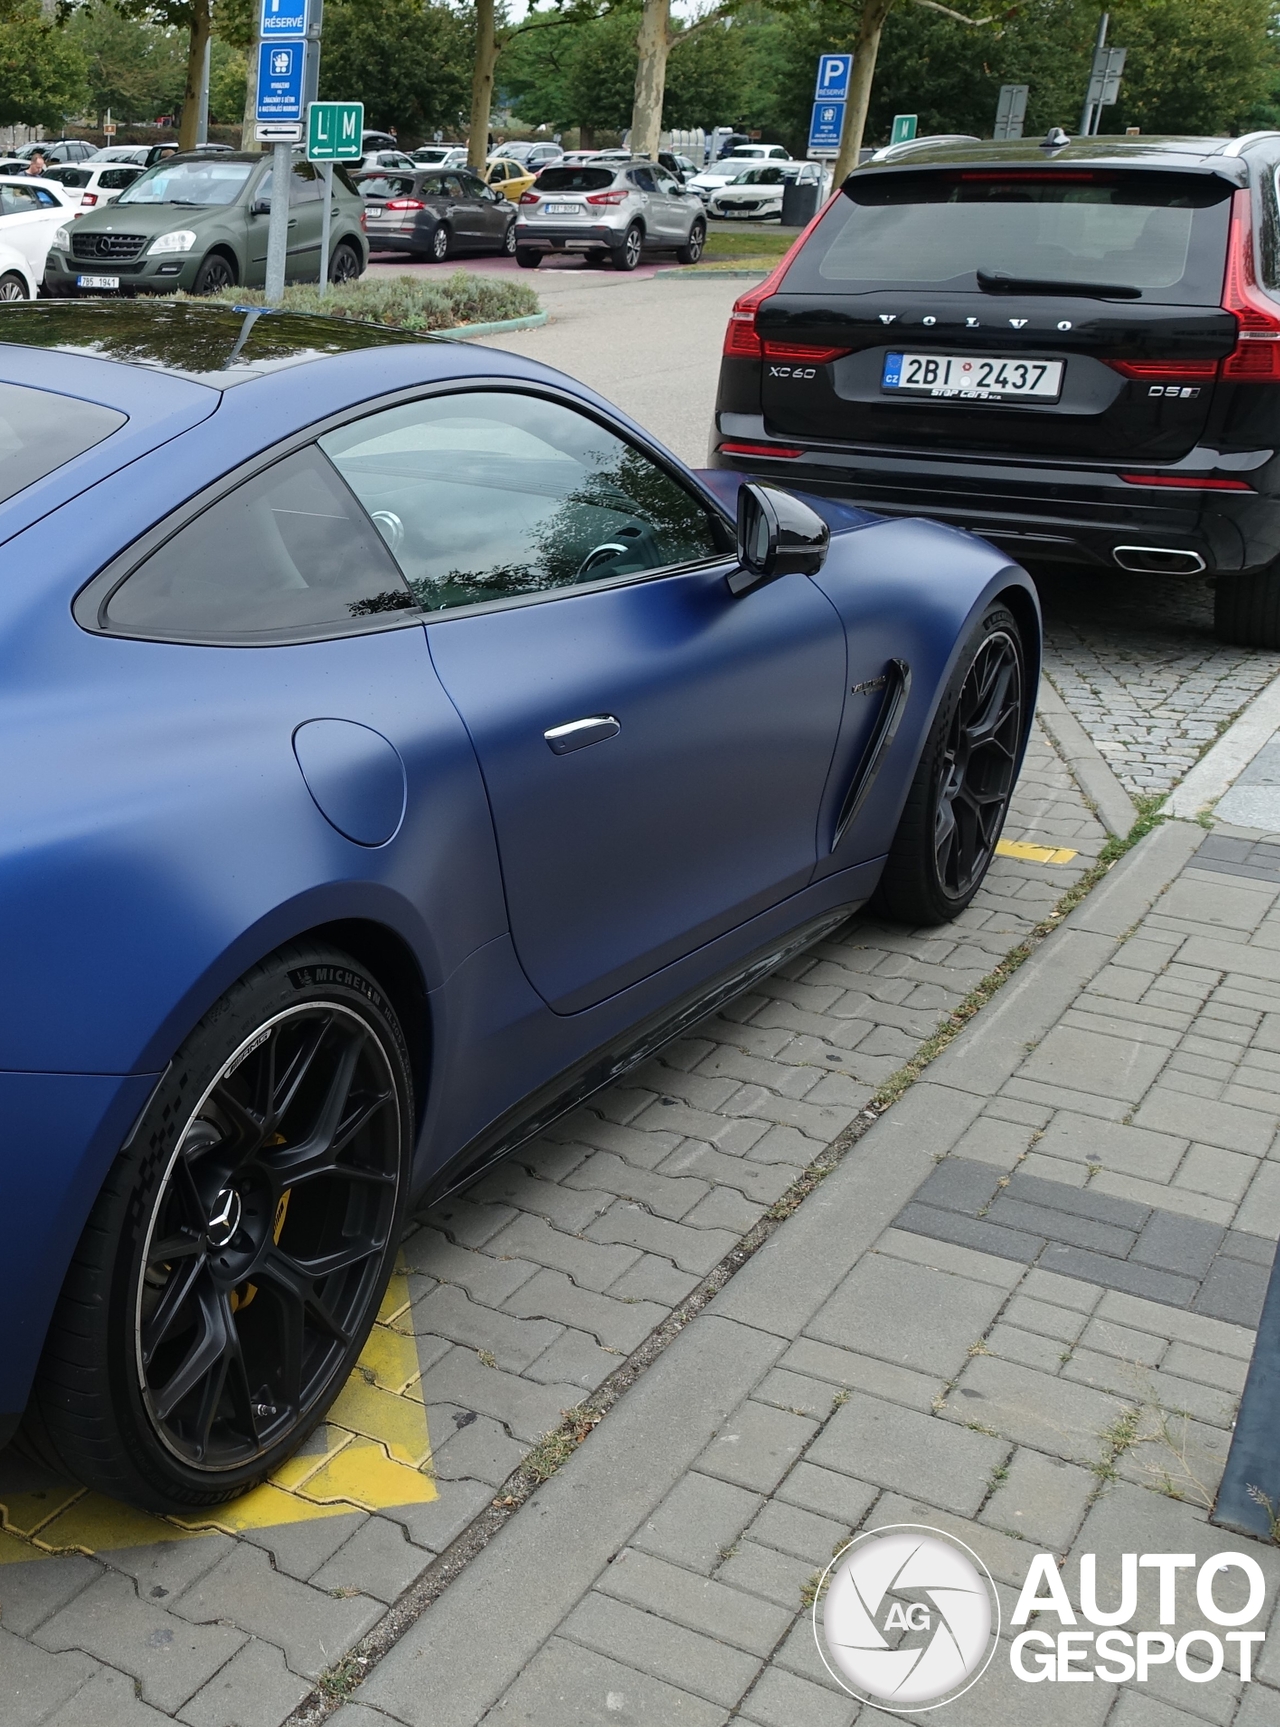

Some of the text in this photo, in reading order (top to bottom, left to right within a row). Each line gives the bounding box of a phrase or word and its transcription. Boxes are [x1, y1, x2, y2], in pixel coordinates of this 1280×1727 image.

[264, 15, 304, 28] RÉSERVÉ
[823, 60, 845, 86] P
[819, 87, 846, 96] RÉSERVÉ
[317, 111, 356, 140] L M
[901, 121, 909, 137] M
[878, 314, 1073, 331] VOLVO
[885, 375, 898, 384] CZ
[906, 359, 1048, 391] 2BI 2437
[930, 388, 959, 397] STOP
[315, 968, 381, 1006] MICHELIN
